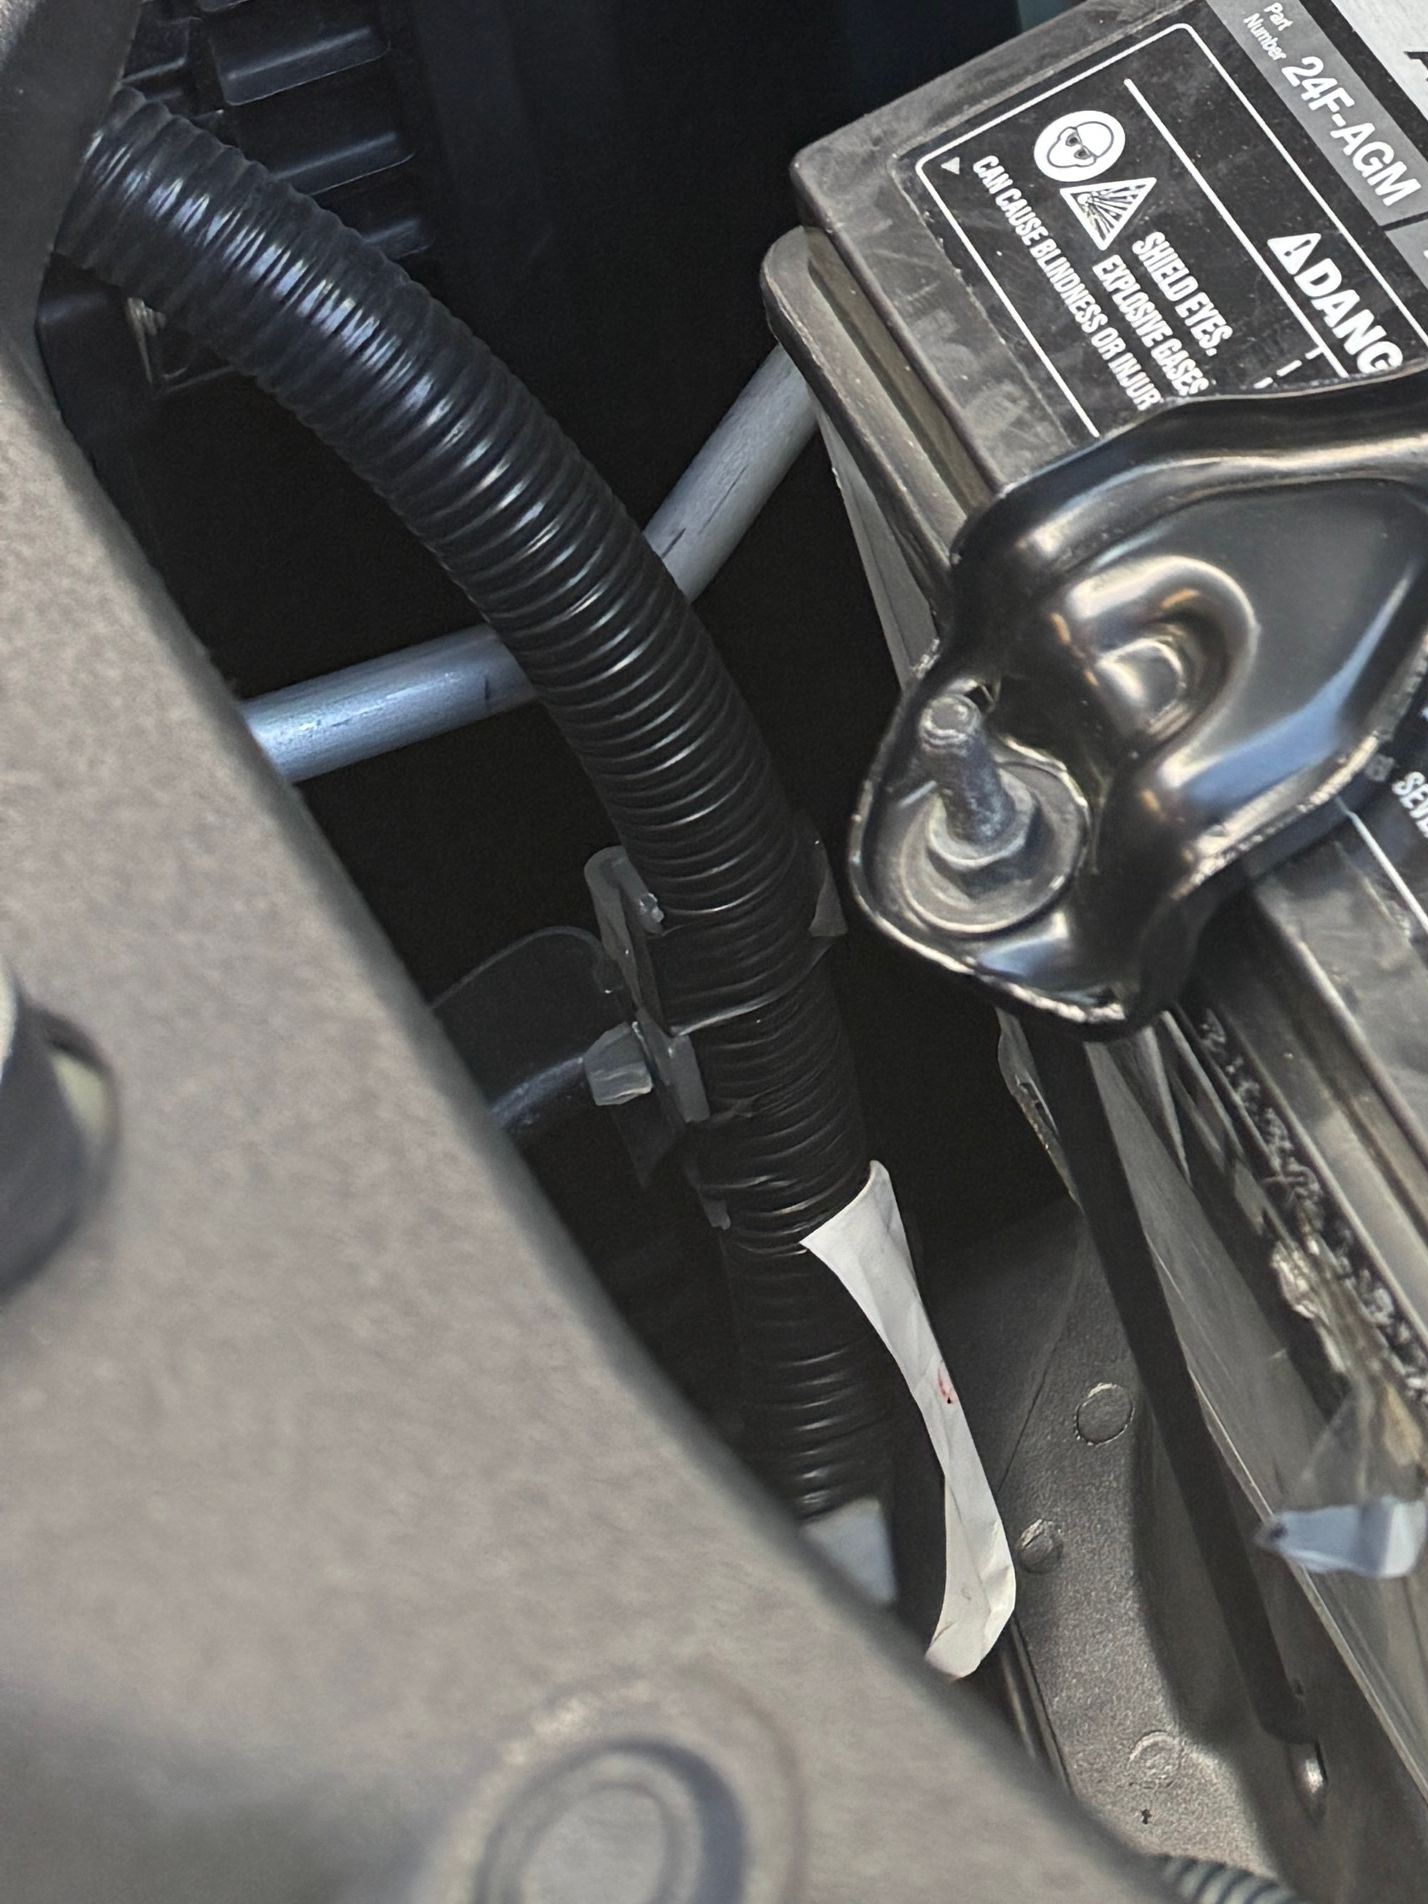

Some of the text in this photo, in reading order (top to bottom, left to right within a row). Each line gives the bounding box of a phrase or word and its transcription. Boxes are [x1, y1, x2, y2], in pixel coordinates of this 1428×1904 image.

[1262, 1, 1294, 32] Part
[1241, 11, 1422, 206] Number 24F-AGM
[972, 154, 1165, 411] CAN CAUSE BLINDNESS OR INJUR
[1091, 253, 1173, 348] EXPLOSIVE
[1130, 230, 1233, 357] SHIELD EYES.
